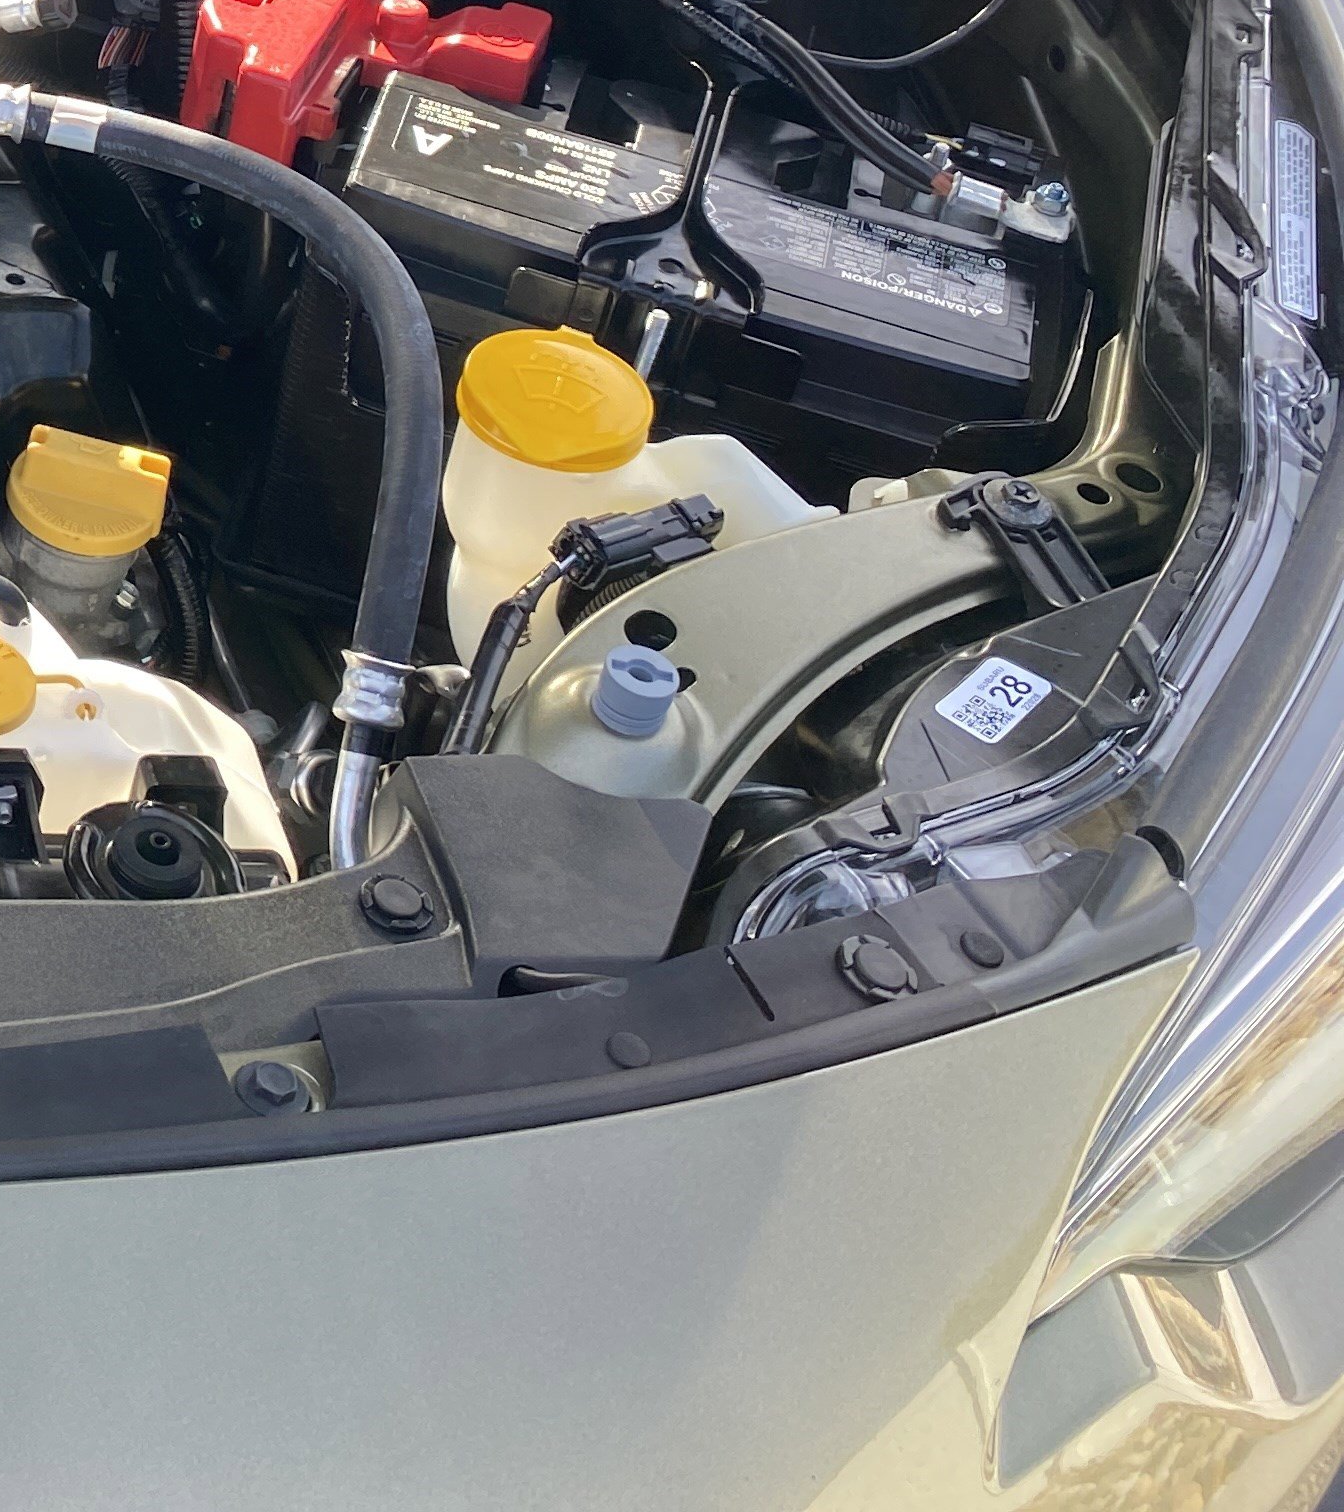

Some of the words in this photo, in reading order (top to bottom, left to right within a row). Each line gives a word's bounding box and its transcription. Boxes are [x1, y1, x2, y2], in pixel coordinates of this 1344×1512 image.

[483, 164, 515, 180] AMPS
[534, 169, 579, 187] AMPS
[515, 173, 573, 196] CRANKING
[572, 189, 605, 204] COLD
[840, 269, 970, 317] DANGER/POISON
[977, 665, 1005, 691] SUBARU
[989, 674, 1033, 708] 28
